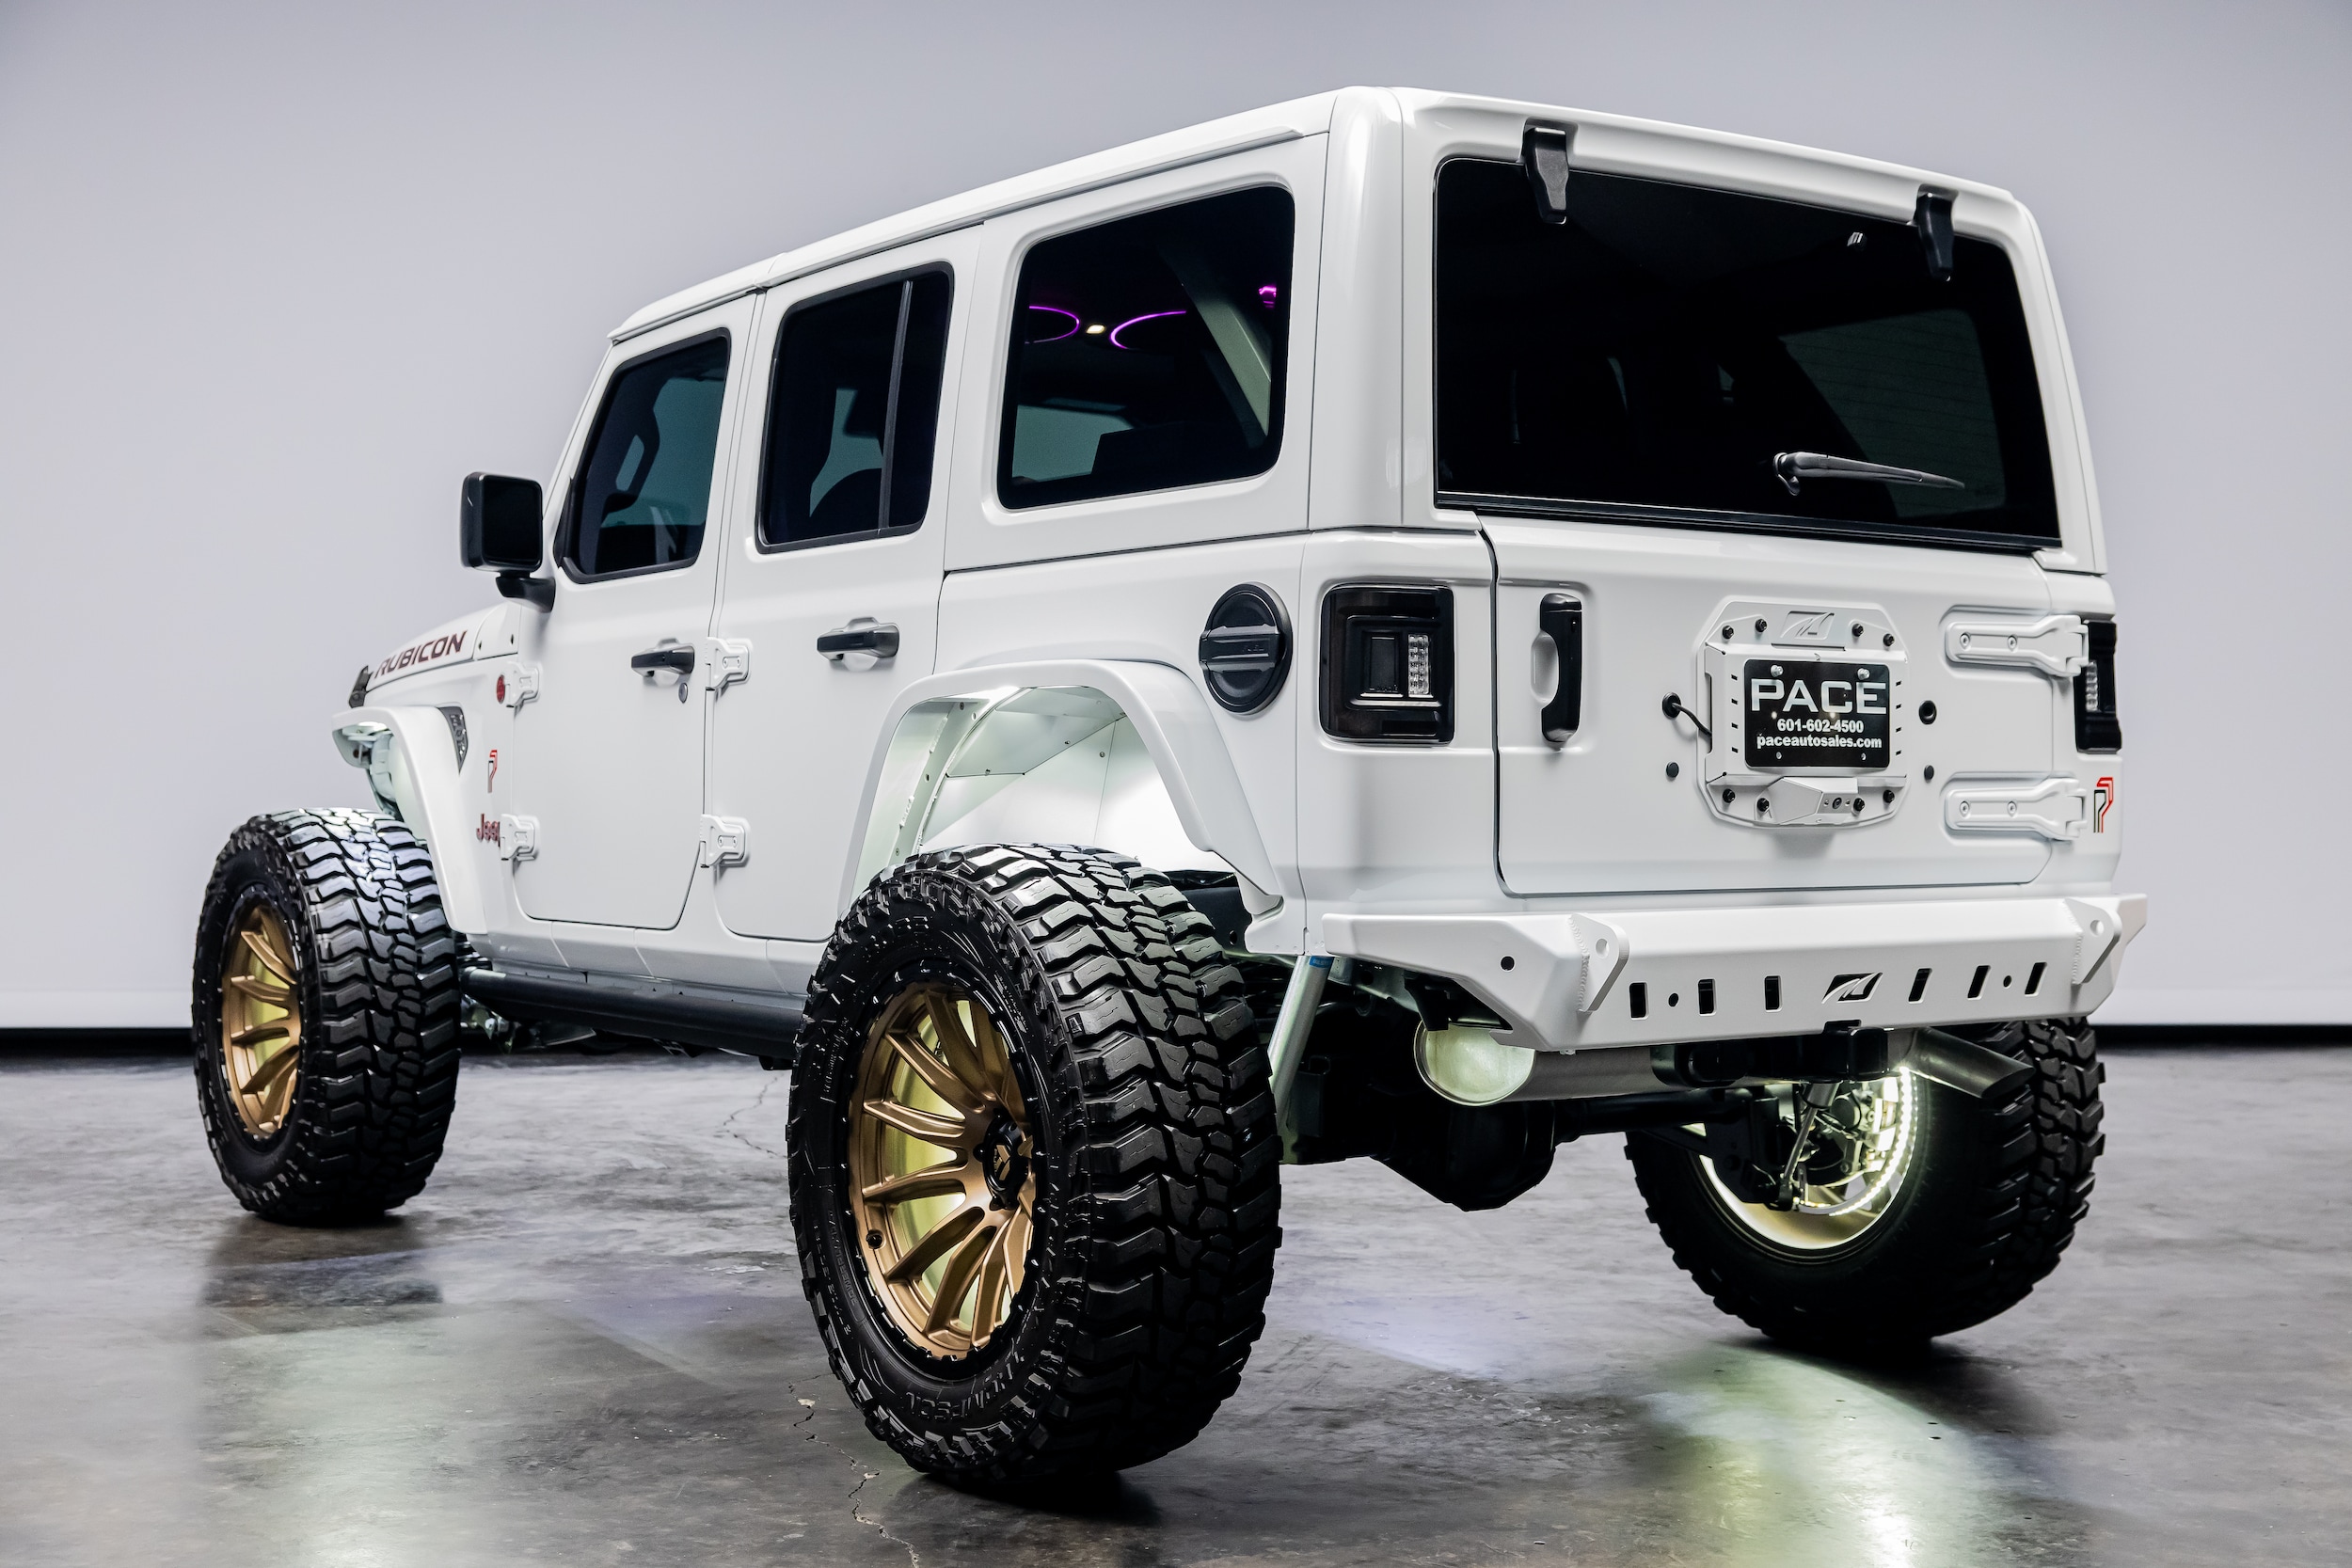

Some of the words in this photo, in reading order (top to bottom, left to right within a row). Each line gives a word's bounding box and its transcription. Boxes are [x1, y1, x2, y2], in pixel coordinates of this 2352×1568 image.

[373, 629, 468, 679] RUBICON
[1751, 678, 1887, 715] PACE
[1776, 718, 1865, 734] 601-602-4500
[1756, 734, 1883, 750] paceautosales.com
